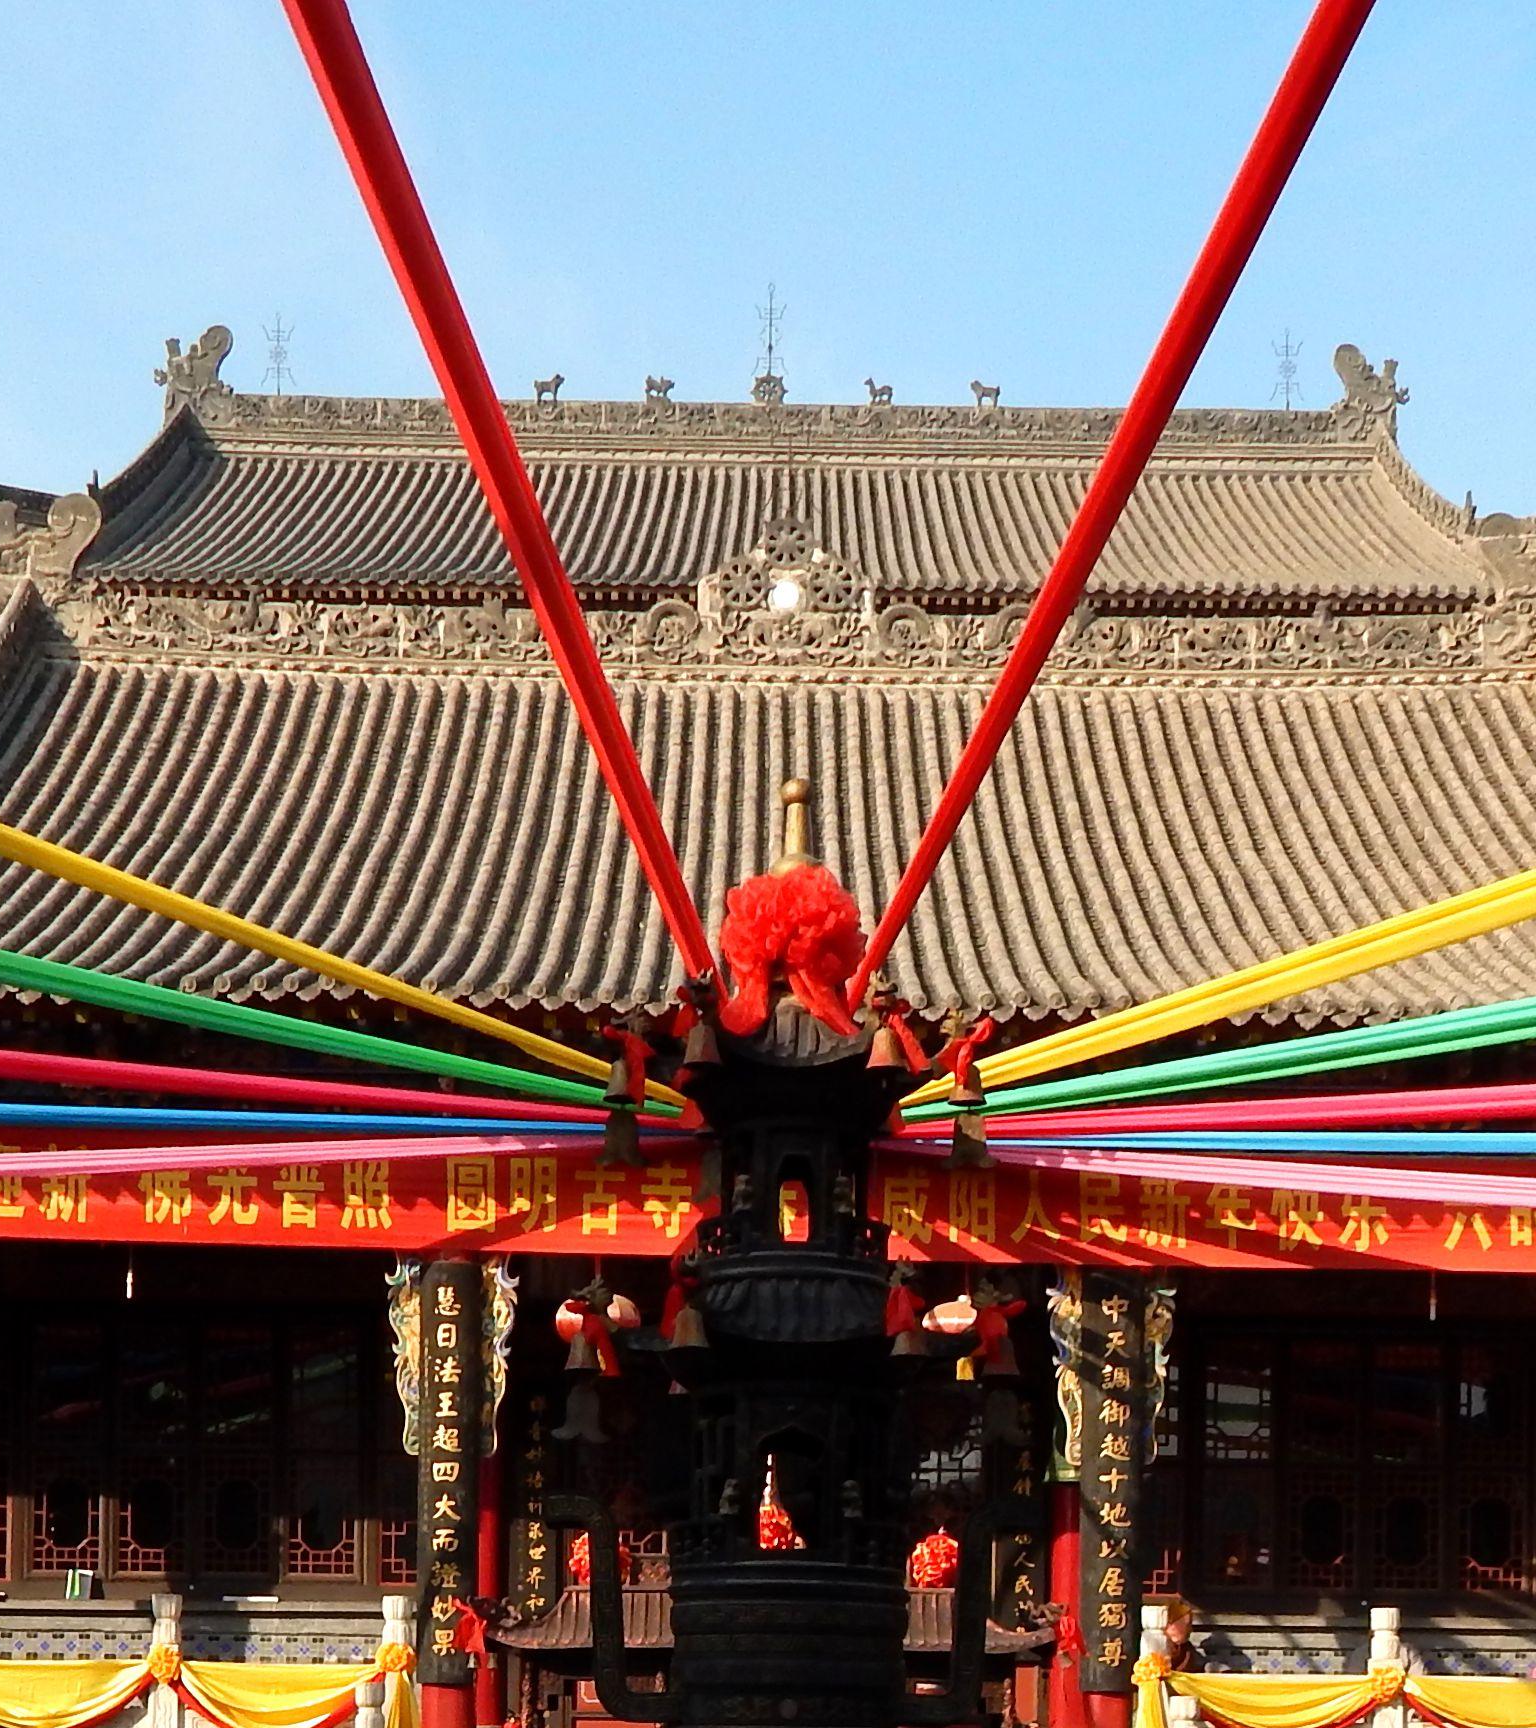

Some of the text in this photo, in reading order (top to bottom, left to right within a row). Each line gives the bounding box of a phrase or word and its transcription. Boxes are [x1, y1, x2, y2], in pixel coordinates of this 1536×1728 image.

[138, 1160, 393, 1230] 佛光普照
[447, 1156, 692, 1238] 圆明古寺
